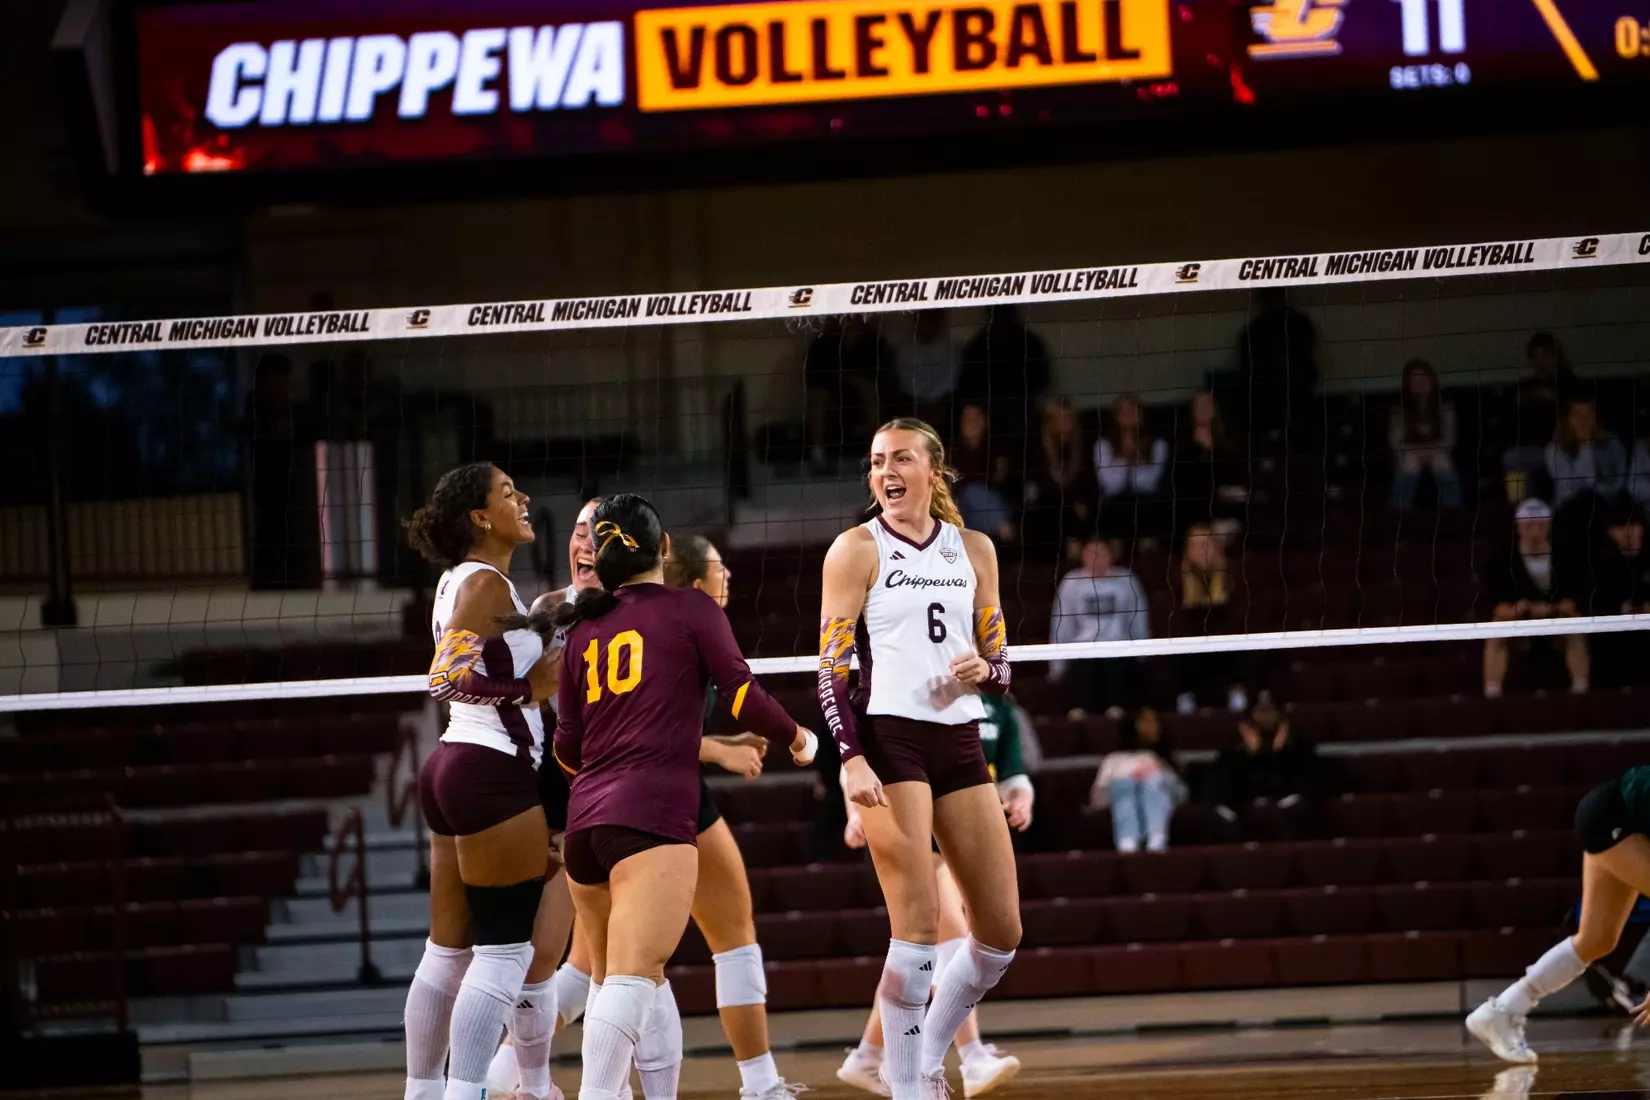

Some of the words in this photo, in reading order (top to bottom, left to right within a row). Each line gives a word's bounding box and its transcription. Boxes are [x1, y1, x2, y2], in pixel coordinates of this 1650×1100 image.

[205, 21, 624, 128] CHIPPEWA
[660, 0, 1141, 89] VOLLEYBALL
[85, 322, 162, 346] CENTRAL
[169, 317, 258, 342] MICHIGAN
[264, 312, 369, 337] VOLLEYBALL
[468, 302, 545, 327] CENTRAL
[552, 297, 641, 322] MICHIGAN
[646, 291, 752, 317] VOLLEYBALL
[851, 281, 928, 305] CENTRAL
[935, 275, 1026, 301] MICHIGAN
[1031, 267, 1138, 295] VOLLEYBALL
[1239, 256, 1318, 281] CENTRAL
[1325, 249, 1418, 276] MICHIGAN
[1423, 242, 1534, 270] VOLLEYBALL
[884, 569, 968, 590] Chippewas
[927, 602, 947, 643] 6
[582, 629, 644, 704] 10
